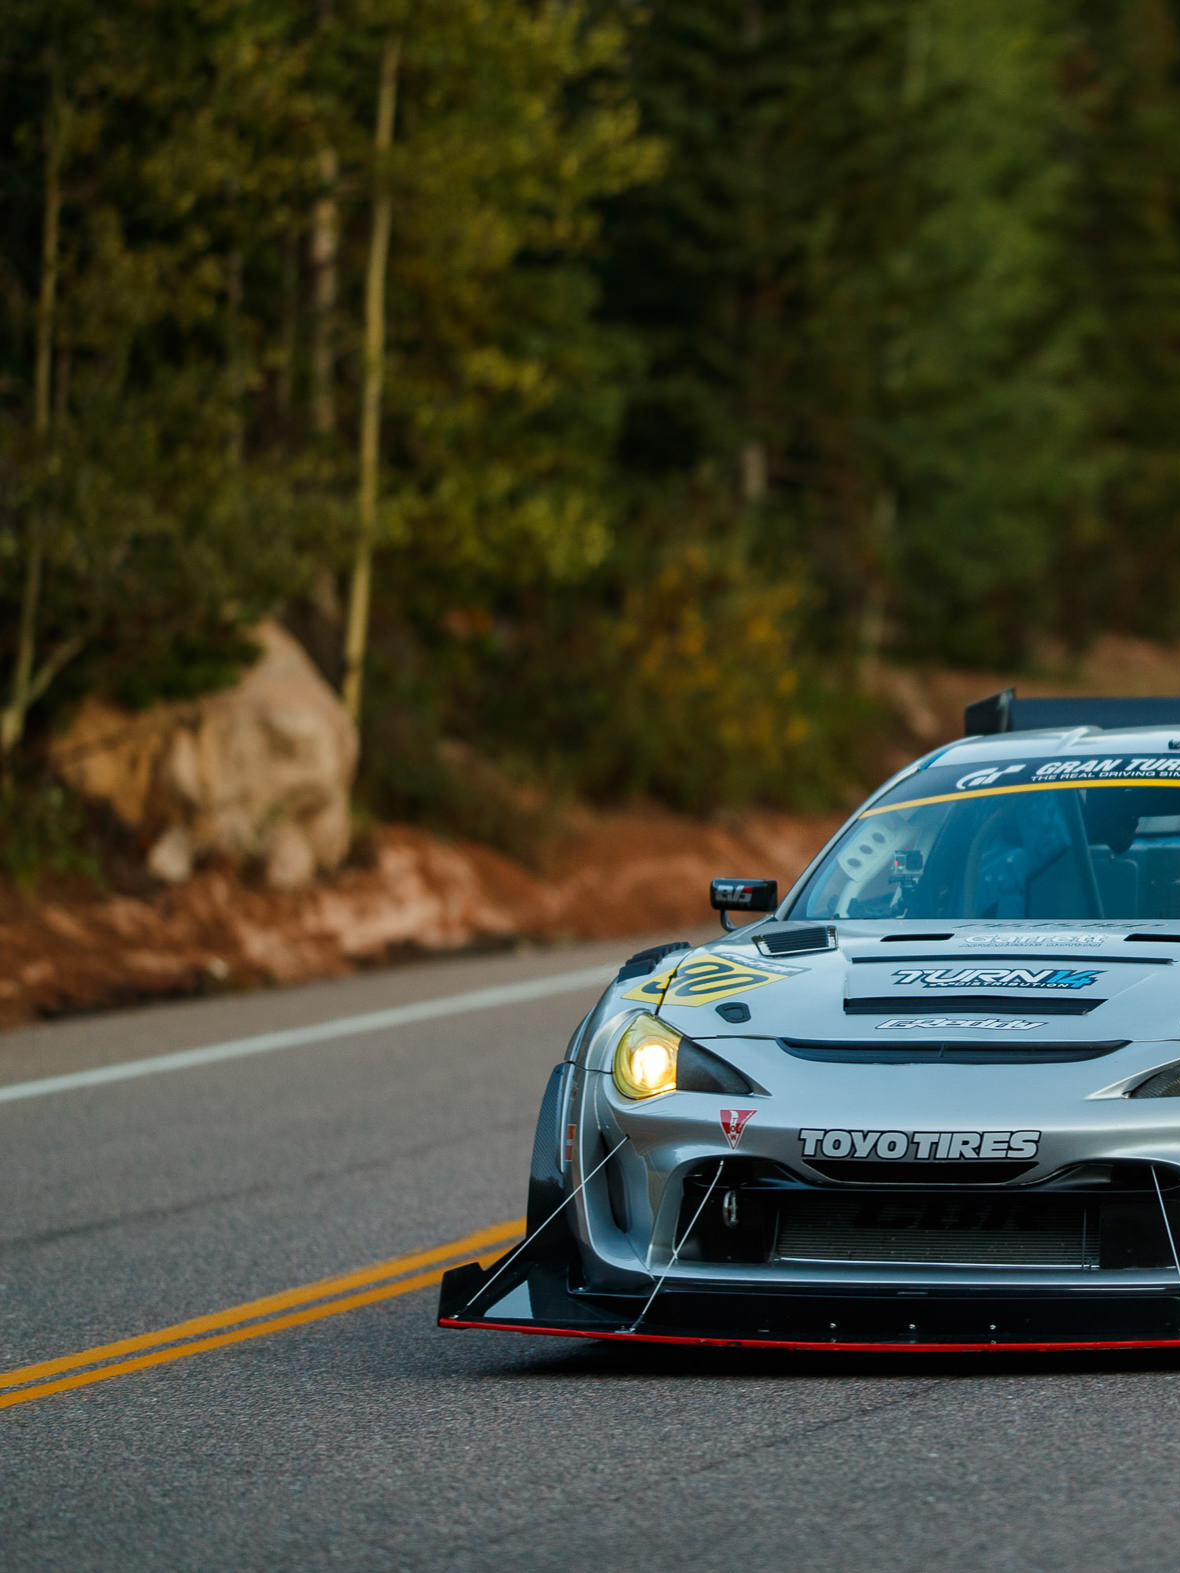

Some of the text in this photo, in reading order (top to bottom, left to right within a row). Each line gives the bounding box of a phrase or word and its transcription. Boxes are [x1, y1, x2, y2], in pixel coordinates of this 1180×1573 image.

[1031, 774, 1057, 782] THE
[1060, 772, 1096, 780] REAL
[1099, 770, 1156, 778] DRIVING
[1035, 759, 1123, 776] GRAN
[641, 961, 769, 997] 90
[800, 1129, 1041, 1160] TOYO TIRES
